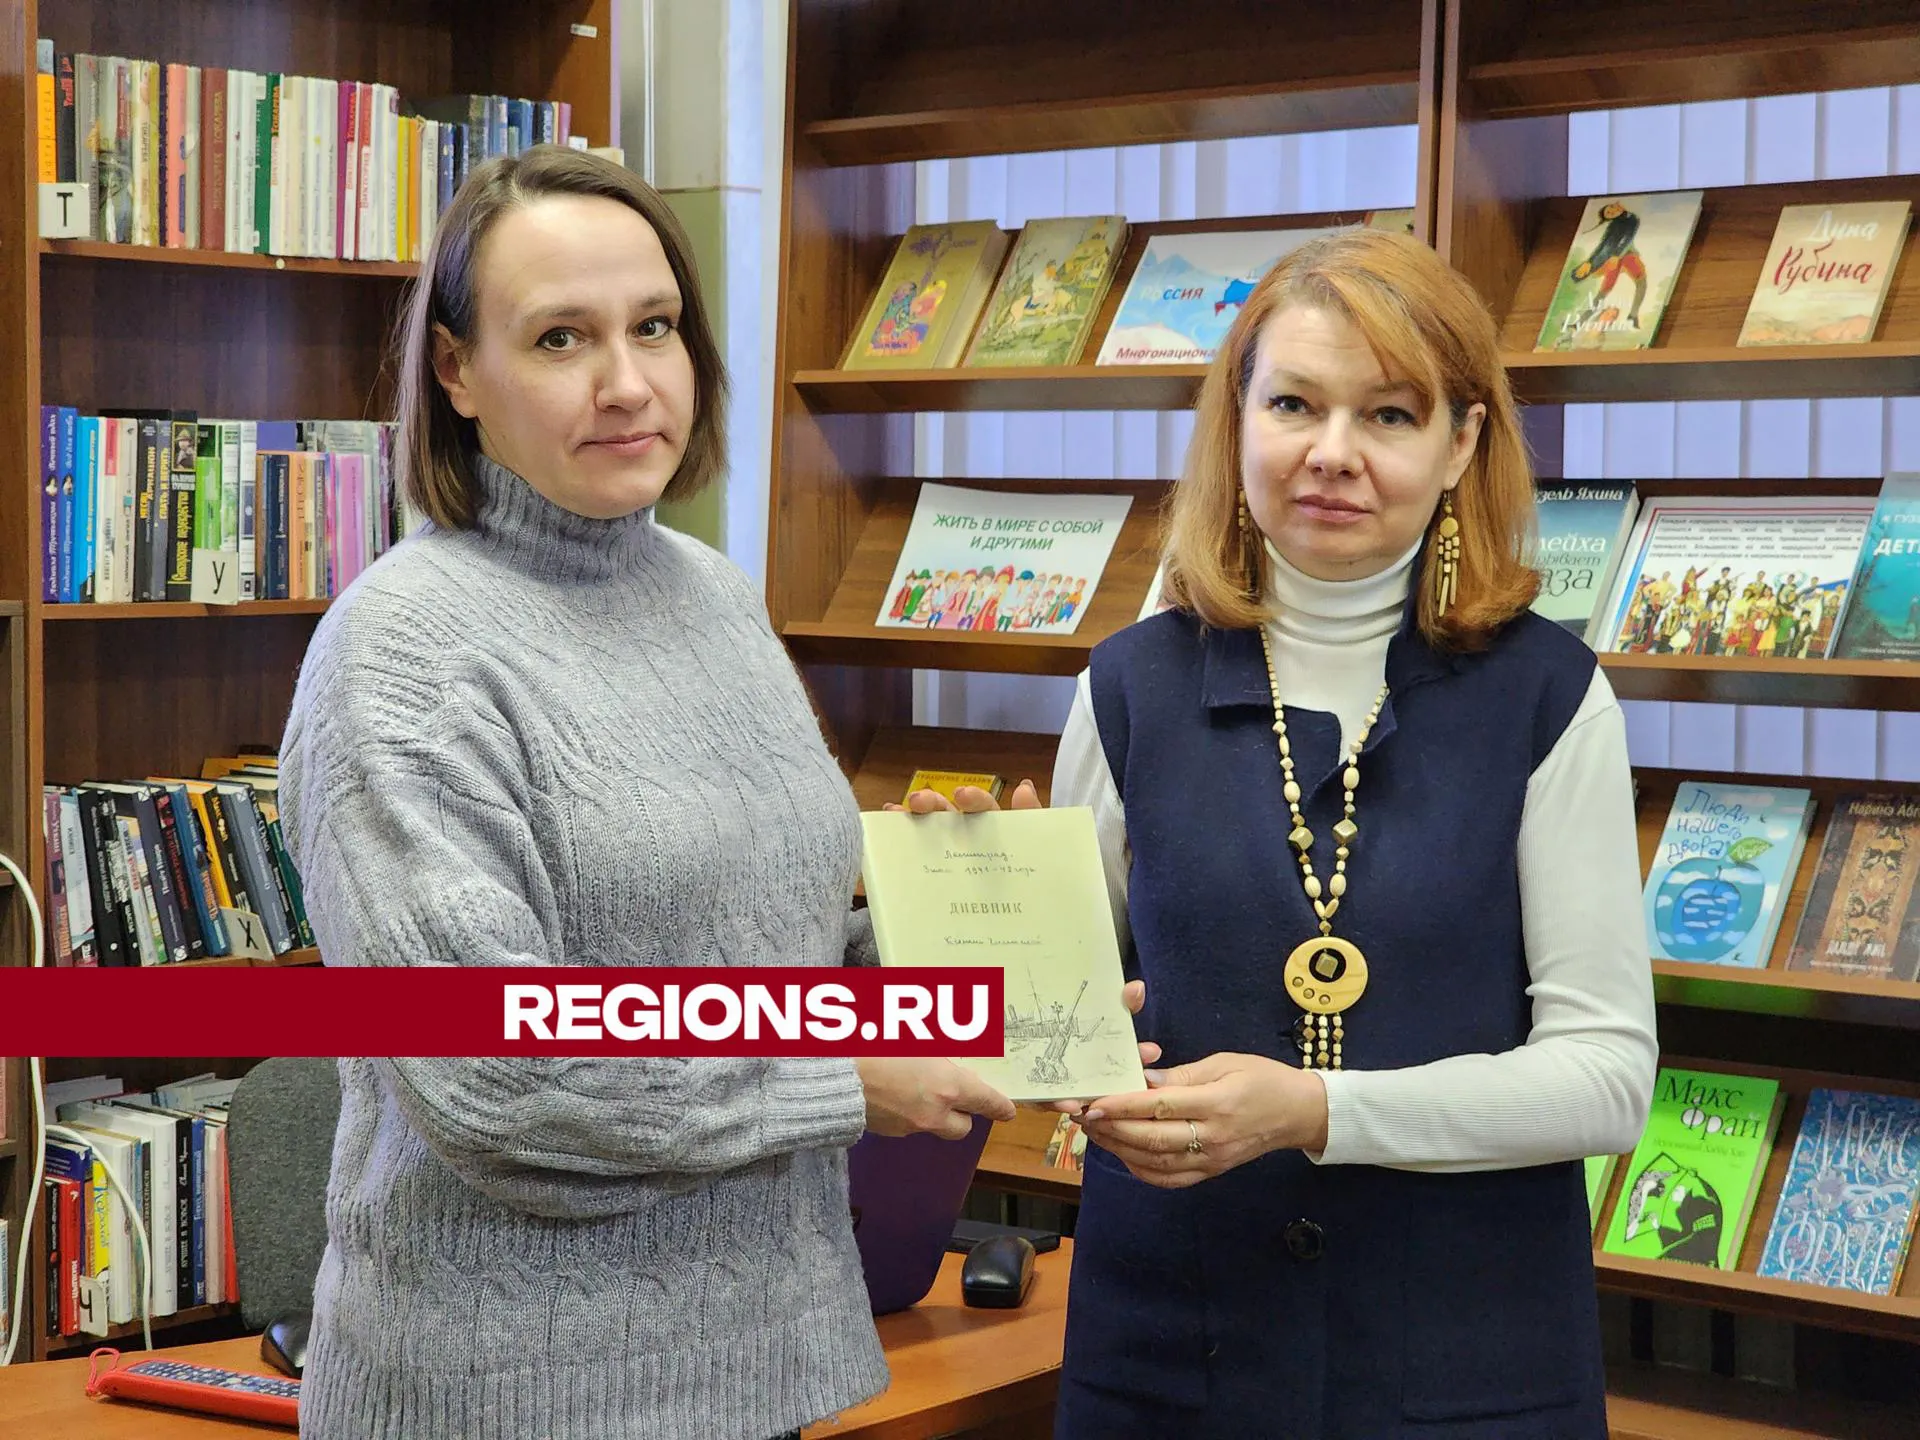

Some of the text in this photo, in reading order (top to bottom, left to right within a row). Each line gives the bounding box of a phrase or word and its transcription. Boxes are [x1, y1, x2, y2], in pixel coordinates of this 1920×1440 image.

[57, 192, 73, 227] Т
[1773, 238, 1875, 295] Рубина
[1575, 486, 1625, 501] Яхина
[933, 513, 1104, 535] ЖИТЬ В МИРЕ С СОБОЙ
[970, 535, 1055, 552] И ДРУГИМИ
[950, 902, 1023, 916] ДНЕВНИК
[1662, 1075, 1744, 1110] Макс
[1680, 1106, 1761, 1141] Фрай
